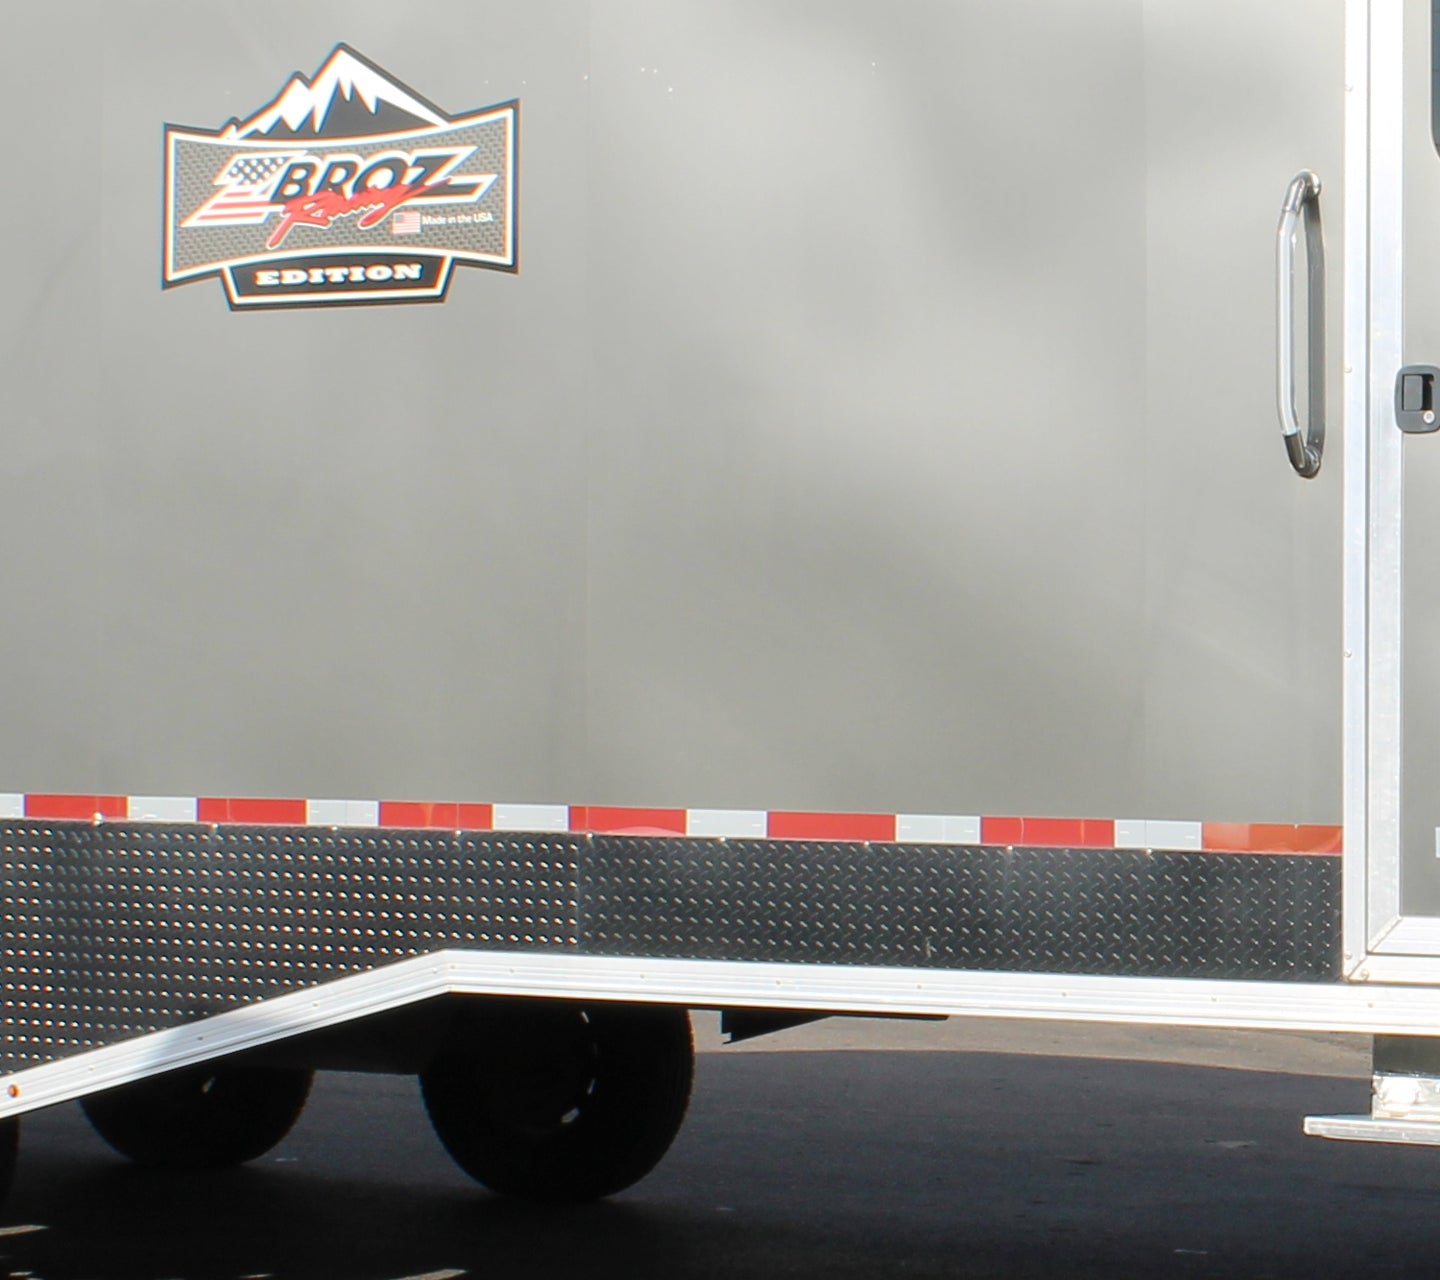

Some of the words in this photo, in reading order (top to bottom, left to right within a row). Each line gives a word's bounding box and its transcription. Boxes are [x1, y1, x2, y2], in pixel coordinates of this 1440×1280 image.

[266, 147, 496, 204] BROZ
[421, 215, 446, 225] Made
[447, 215, 457, 224] in
[457, 213, 472, 224] the
[473, 211, 494, 224] USA
[254, 263, 424, 287] EDITION
